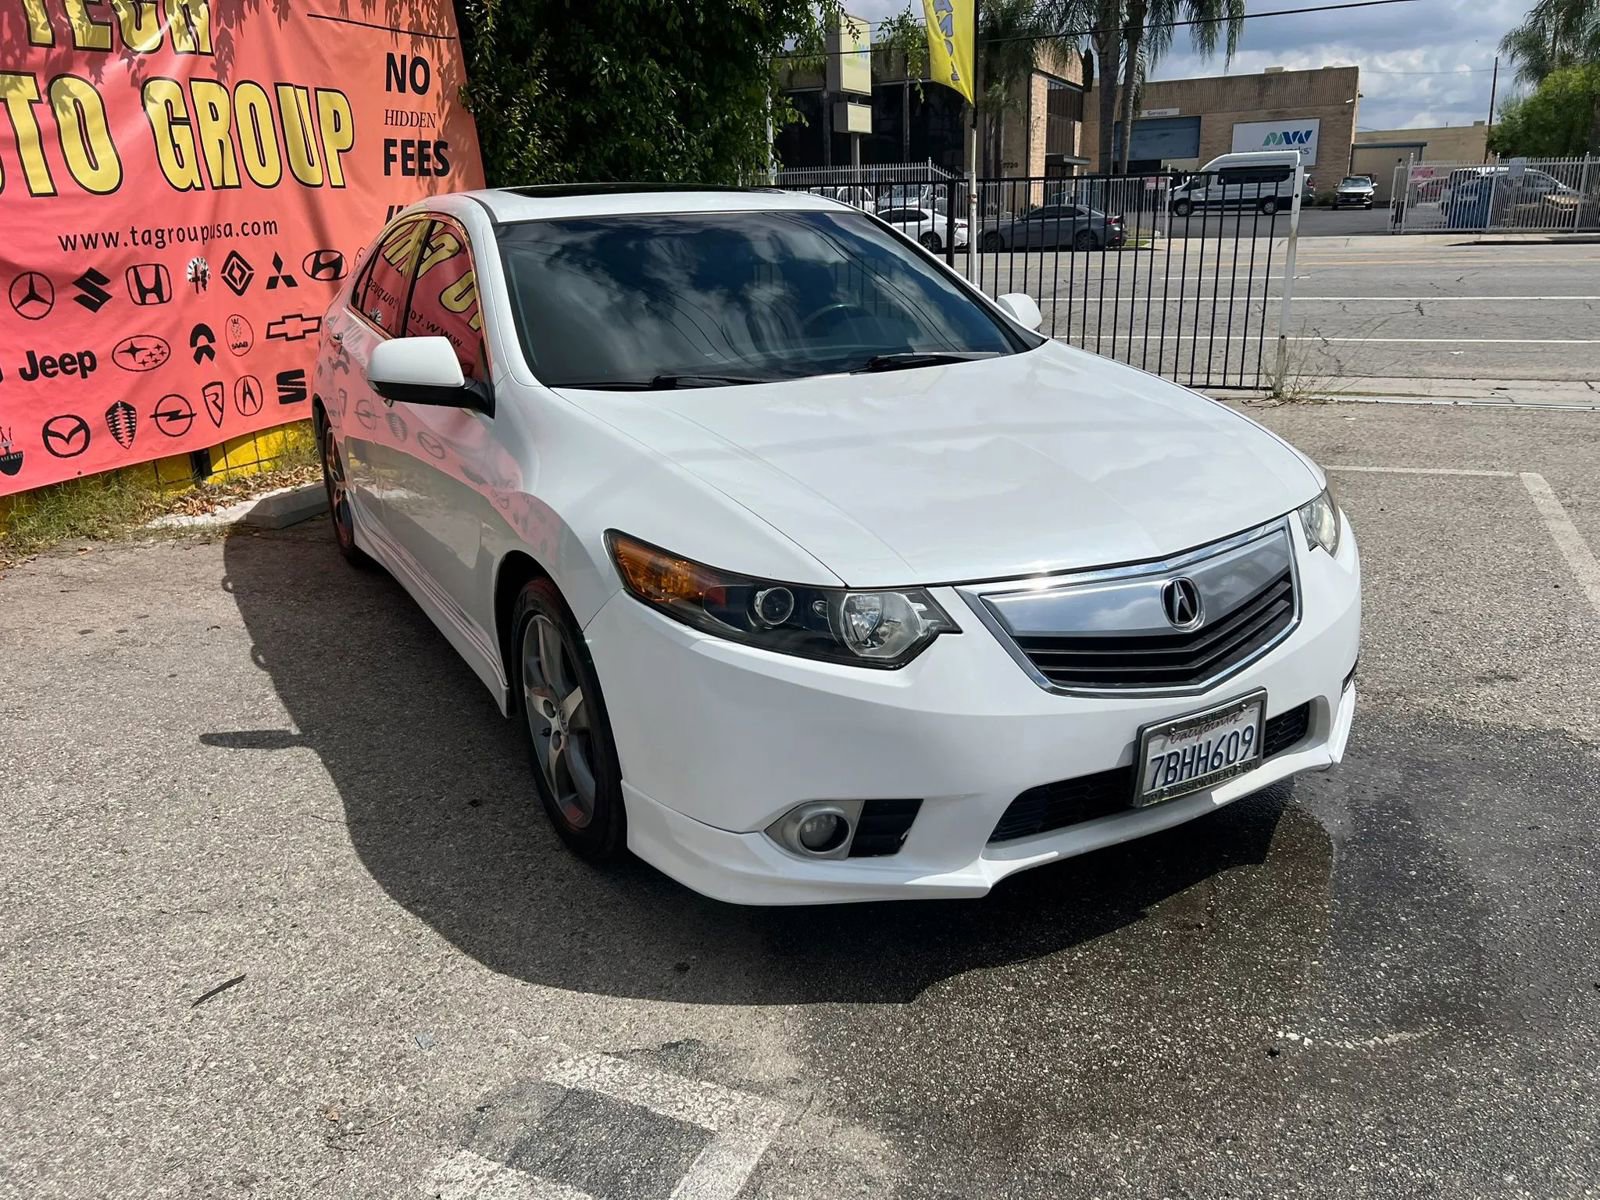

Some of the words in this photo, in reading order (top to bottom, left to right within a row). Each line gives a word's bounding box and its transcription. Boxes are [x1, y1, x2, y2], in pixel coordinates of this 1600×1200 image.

[385, 52, 430, 96] NO
[0, 71, 123, 197] TO
[140, 76, 355, 192] GROUP
[384, 109, 437, 129] HIDDEN
[383, 138, 450, 177] FEES
[58, 218, 279, 252] www.tagroupusa.com
[231, 341, 248, 350] SAAB
[18, 350, 97, 381] Jeep
[1151, 725, 1255, 790] 7BHH609
